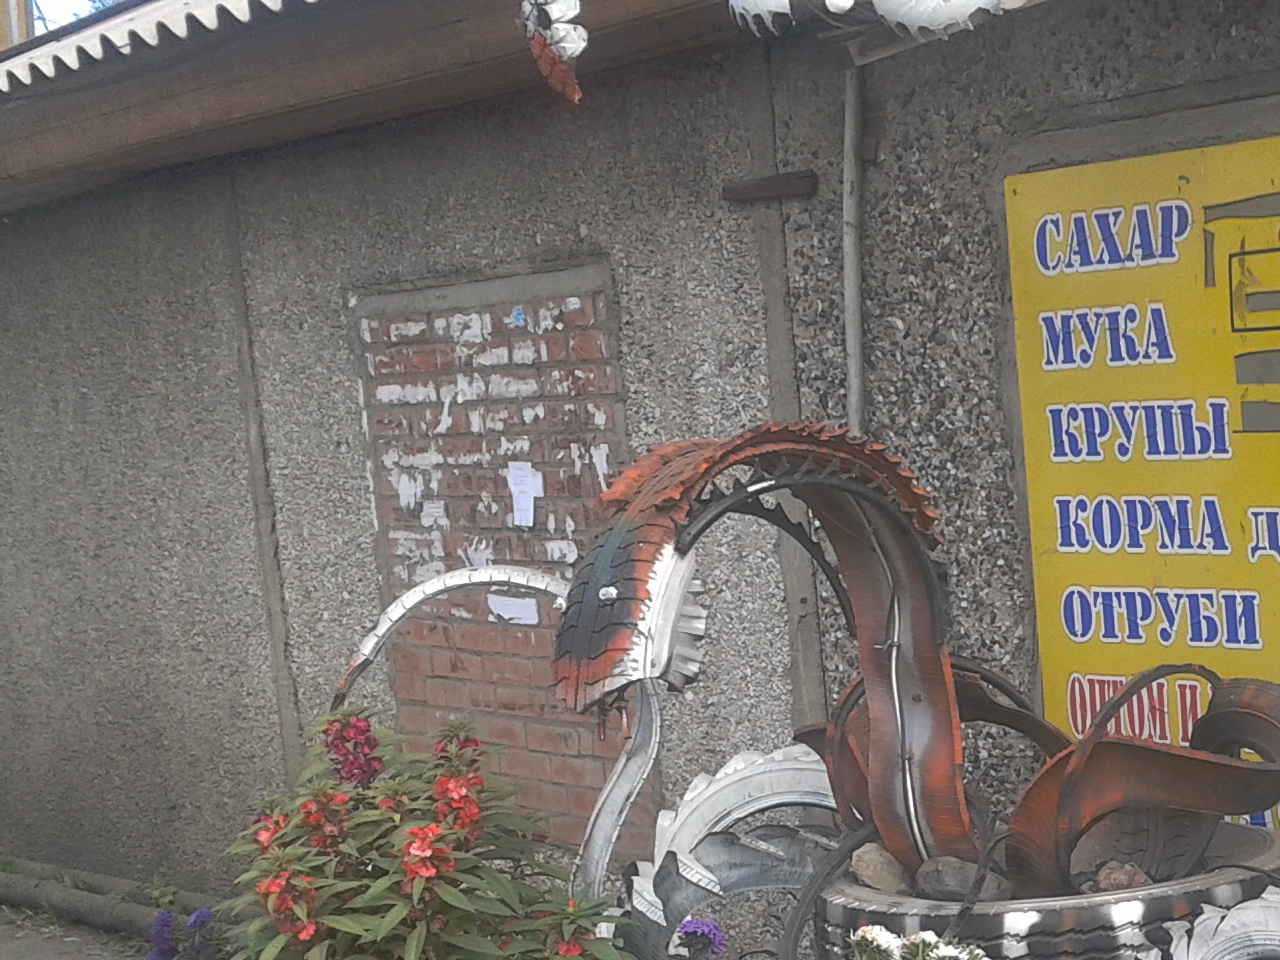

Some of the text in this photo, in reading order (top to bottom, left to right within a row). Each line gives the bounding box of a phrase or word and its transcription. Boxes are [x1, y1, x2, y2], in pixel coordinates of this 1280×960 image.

[1034, 200, 1193, 276] САХАР
[1038, 303, 1176, 370] МУКА
[1046, 398, 1232, 462] КРУПЫ
[1053, 496, 1231, 554] КОРМА
[1061, 586, 1262, 648] ОТРУБИ
